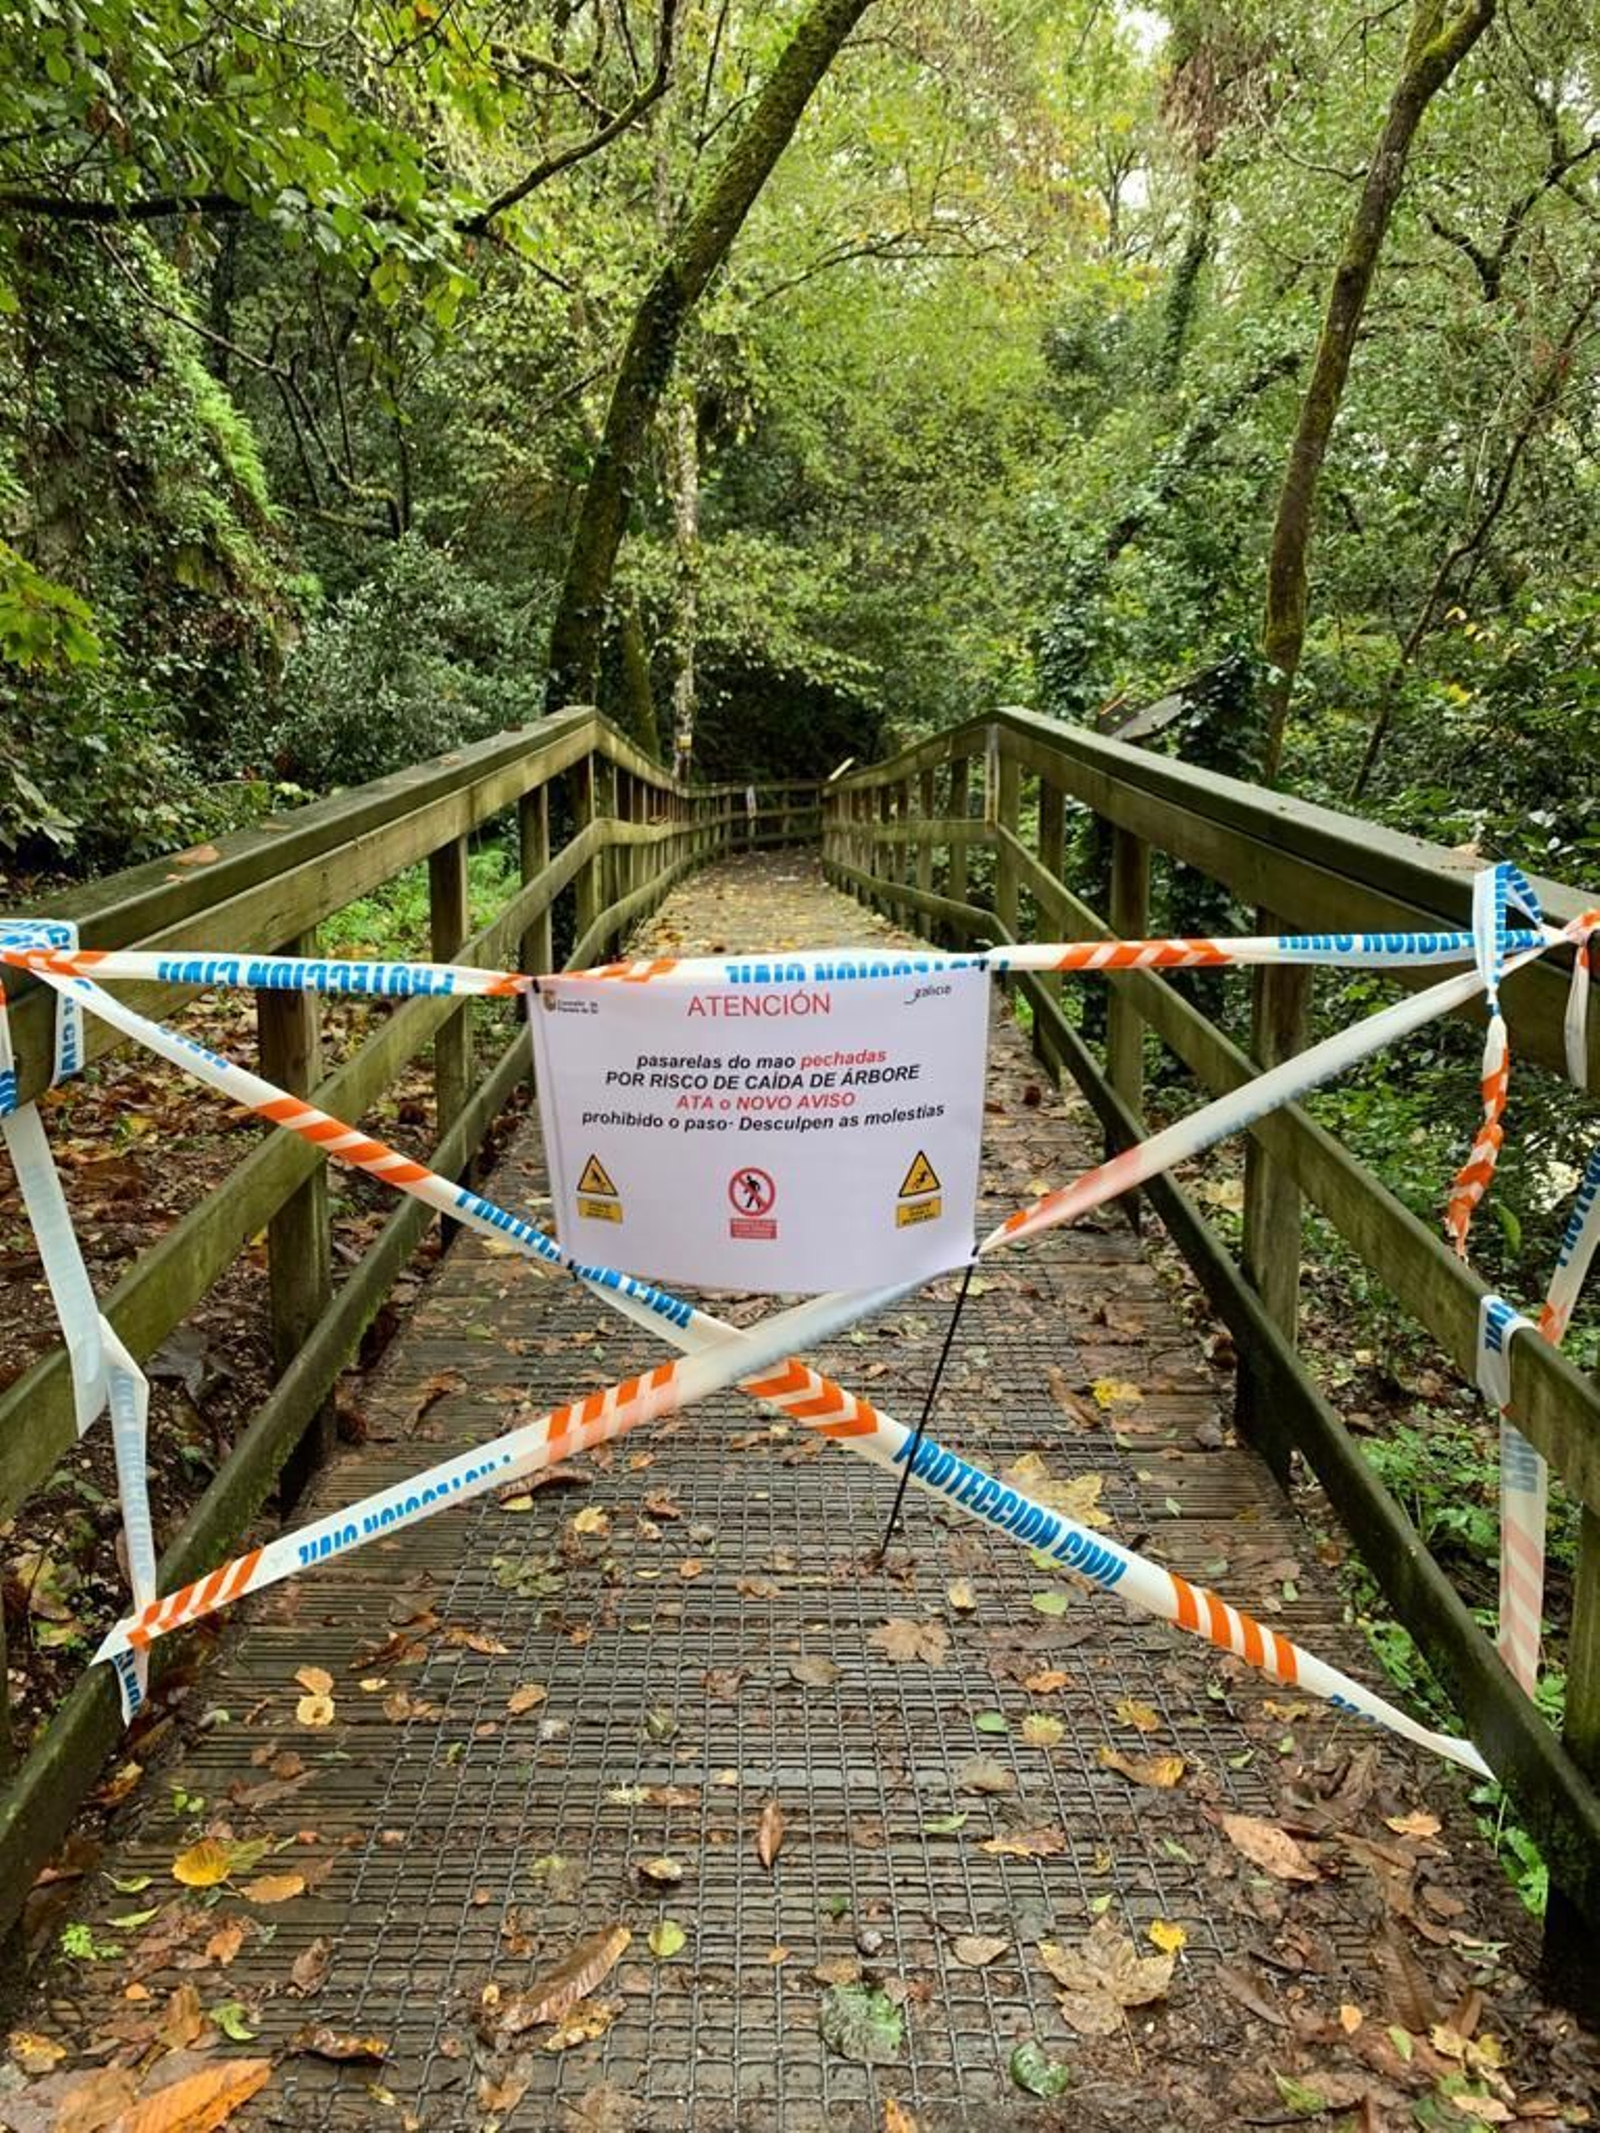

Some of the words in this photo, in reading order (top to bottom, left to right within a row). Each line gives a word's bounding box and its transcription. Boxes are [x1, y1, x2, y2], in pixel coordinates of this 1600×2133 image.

[687, 990, 831, 1017] ATENCIÓN
[636, 1055, 722, 1070] pasarelas
[727, 1055, 751, 1070] do
[756, 1056, 796, 1070] mao
[801, 1050, 887, 1070] pechadas
[606, 1071, 645, 1087] POR
[650, 1073, 708, 1090] RISCO
[713, 1075, 740, 1090] DE
[745, 1071, 804, 1090] CAÍDA
[810, 1072, 837, 1088] DE
[841, 1064, 920, 1087] ÁRBORE
[676, 1095, 714, 1110] ATA
[736, 1095, 793, 1111] NOVO
[797, 1092, 856, 1110] AVISO
[582, 1111, 664, 1128] prohibido
[668, 1117, 680, 1129] o
[738, 1116, 834, 1133] Desculpen
[839, 1113, 859, 1128] as
[864, 1103, 945, 1126] molestias
[892, 1431, 1062, 1550] PROTECCION
